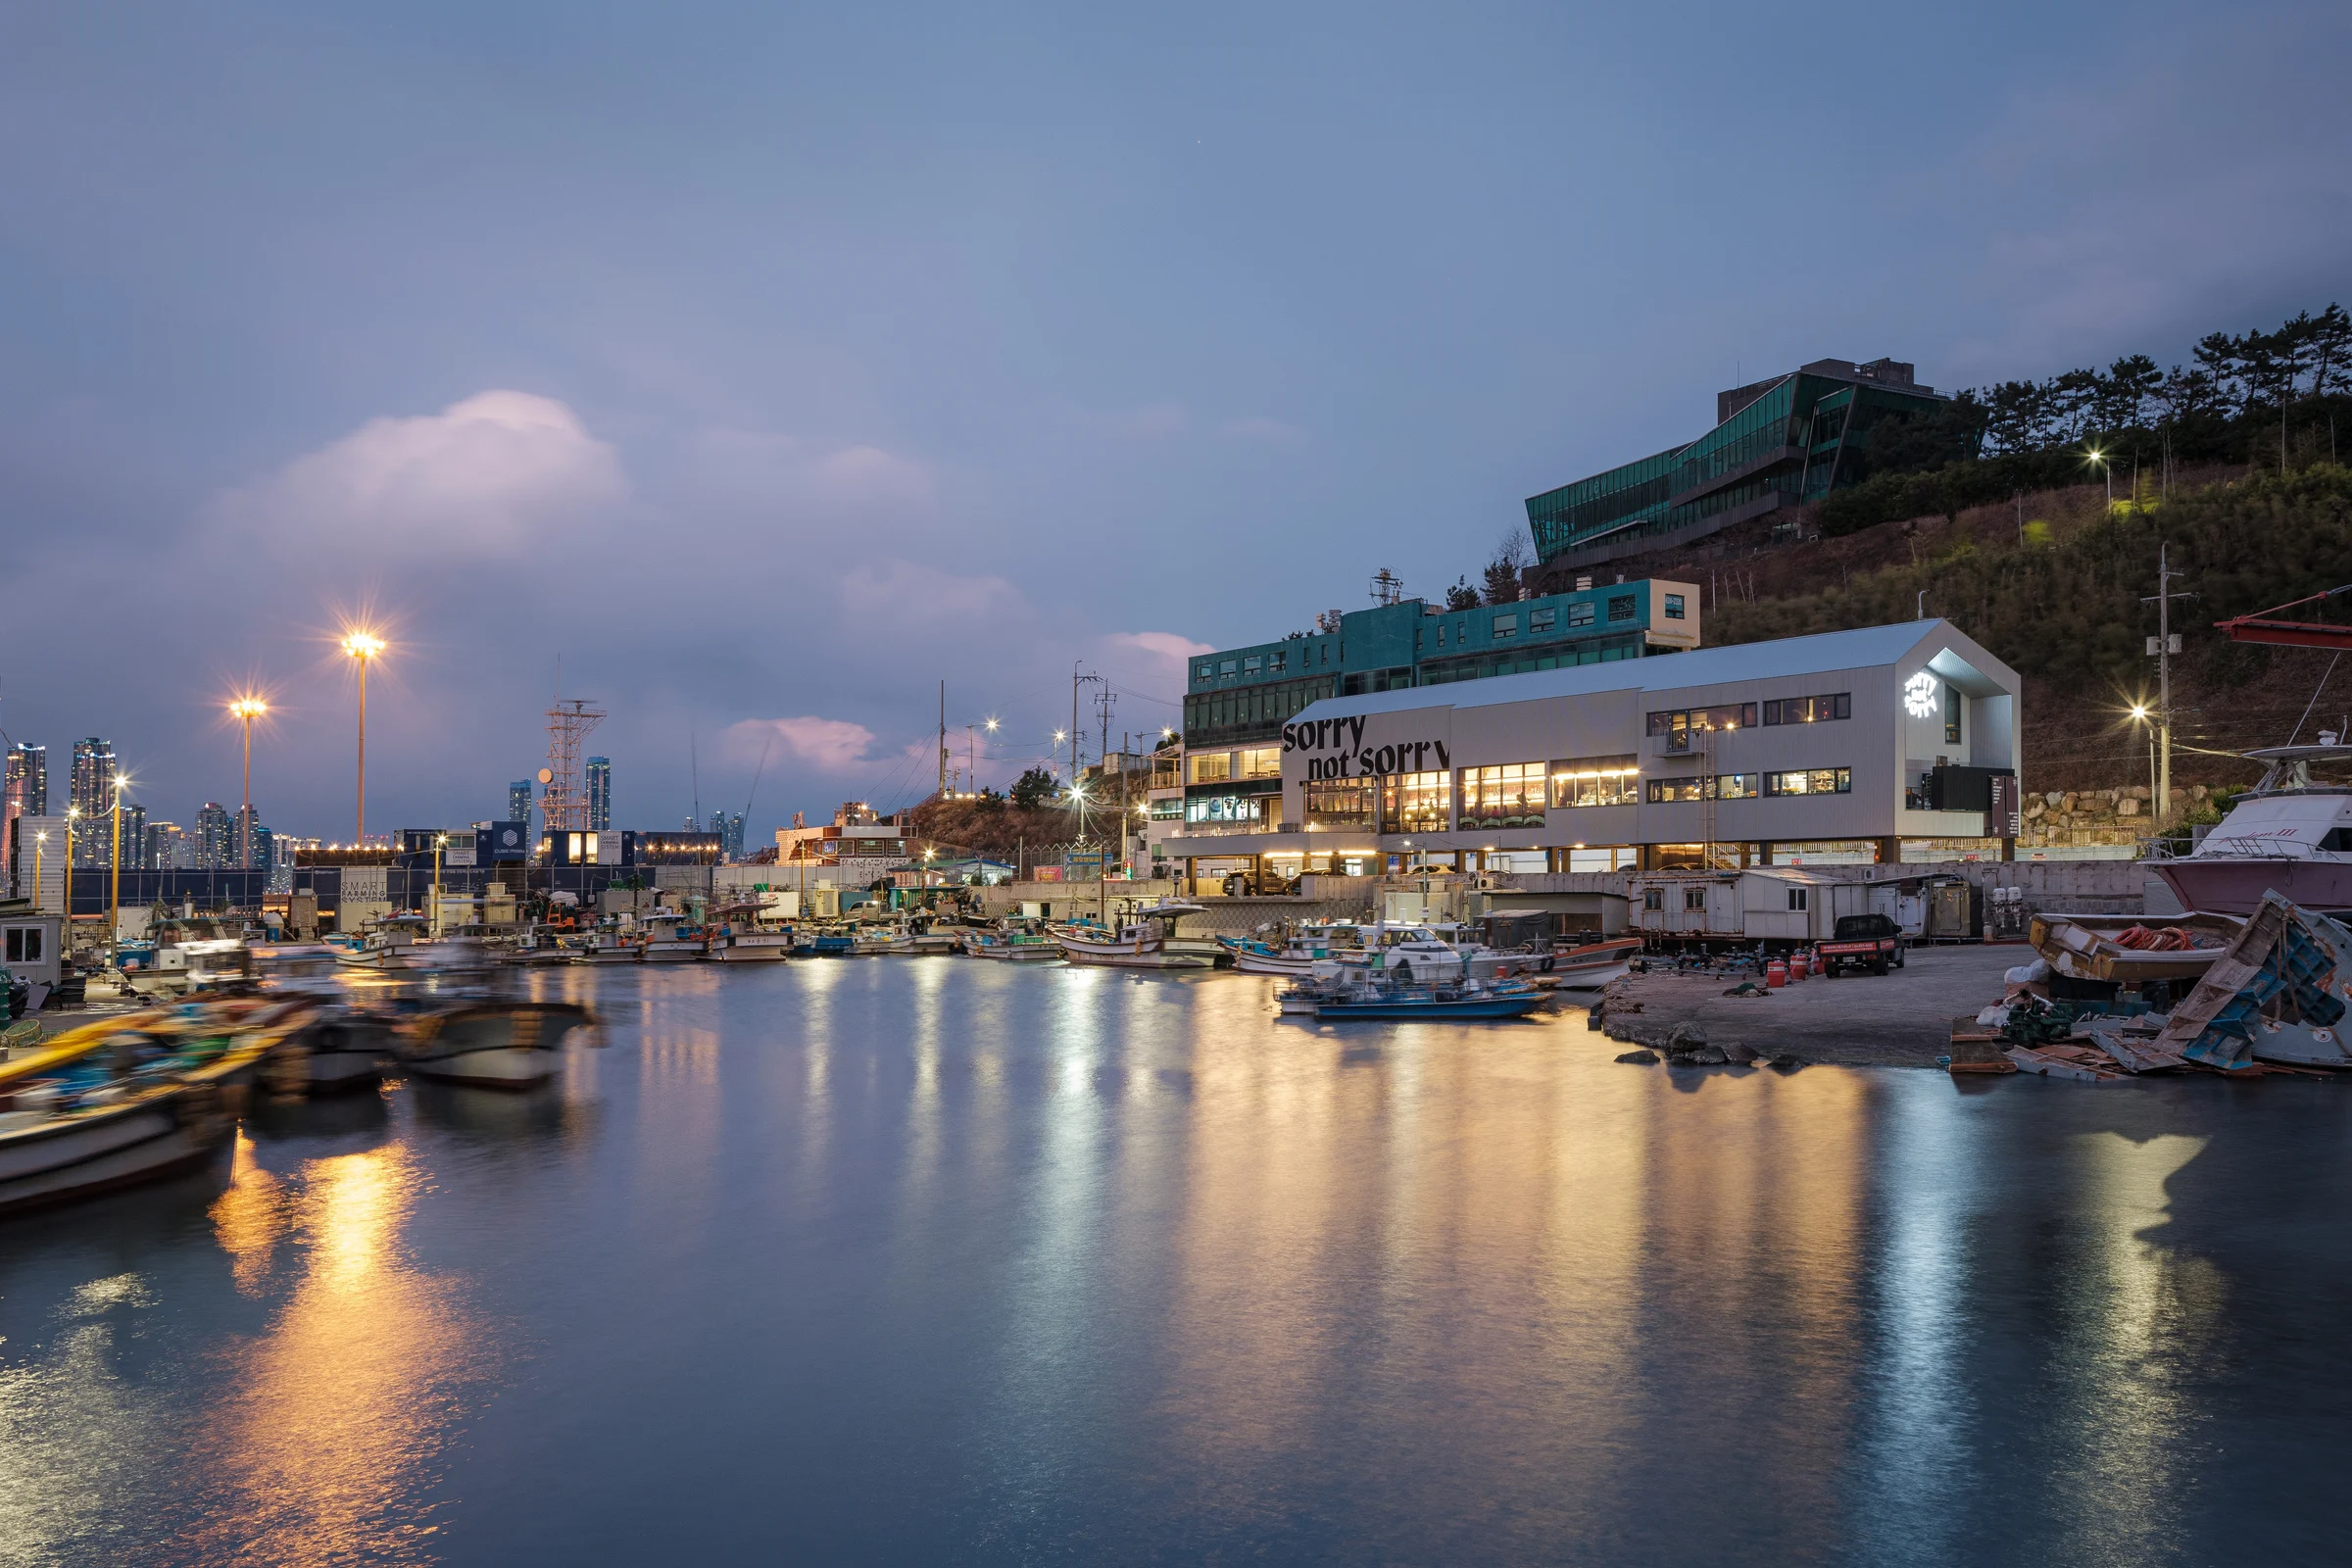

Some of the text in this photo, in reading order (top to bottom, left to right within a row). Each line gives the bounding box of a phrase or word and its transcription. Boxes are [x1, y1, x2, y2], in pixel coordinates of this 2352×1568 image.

[1283, 715, 1366, 758] sorry
[1308, 749, 1349, 780] not
[341, 881, 386, 891] SMART
